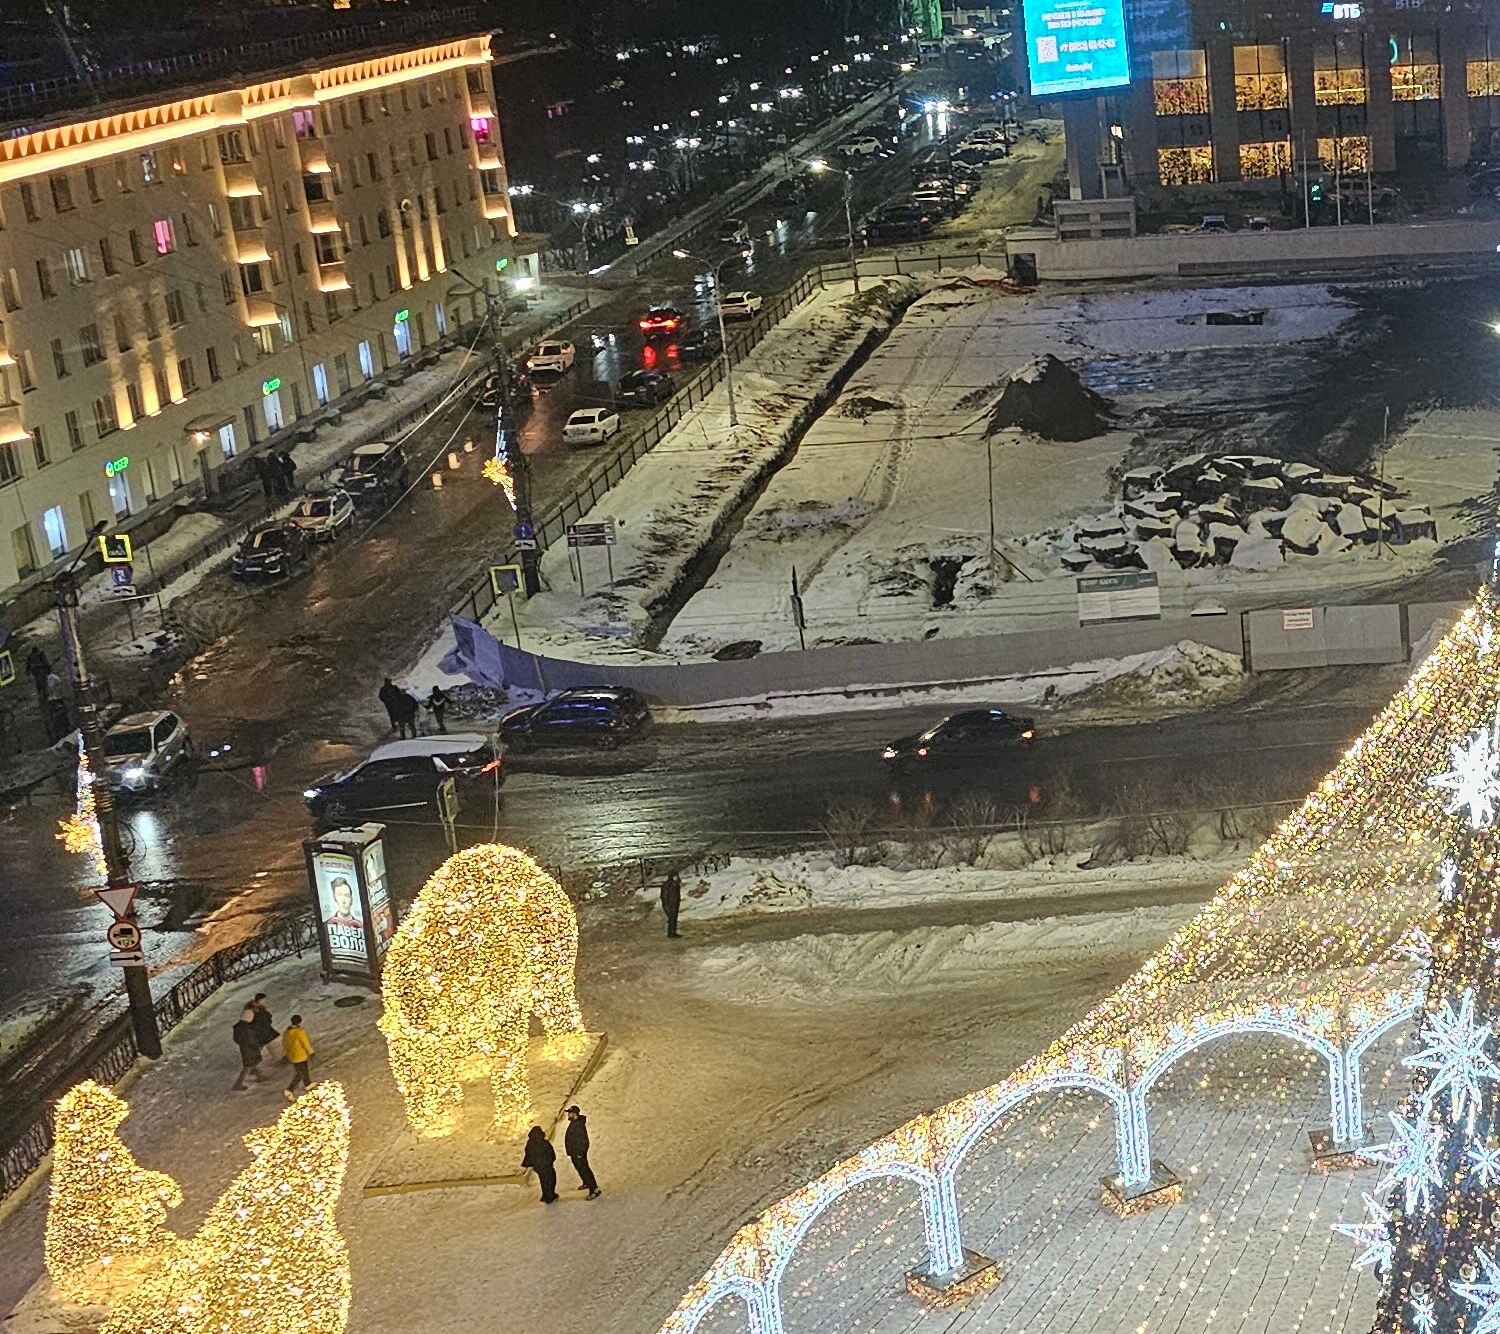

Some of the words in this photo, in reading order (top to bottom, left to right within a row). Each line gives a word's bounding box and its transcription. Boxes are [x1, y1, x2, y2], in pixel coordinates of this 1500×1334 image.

[1333, 3, 1361, 19] ВТБ
[327, 923, 365, 939] ПАВЕЛ
[329, 934, 366, 952] ВОЛЯ
